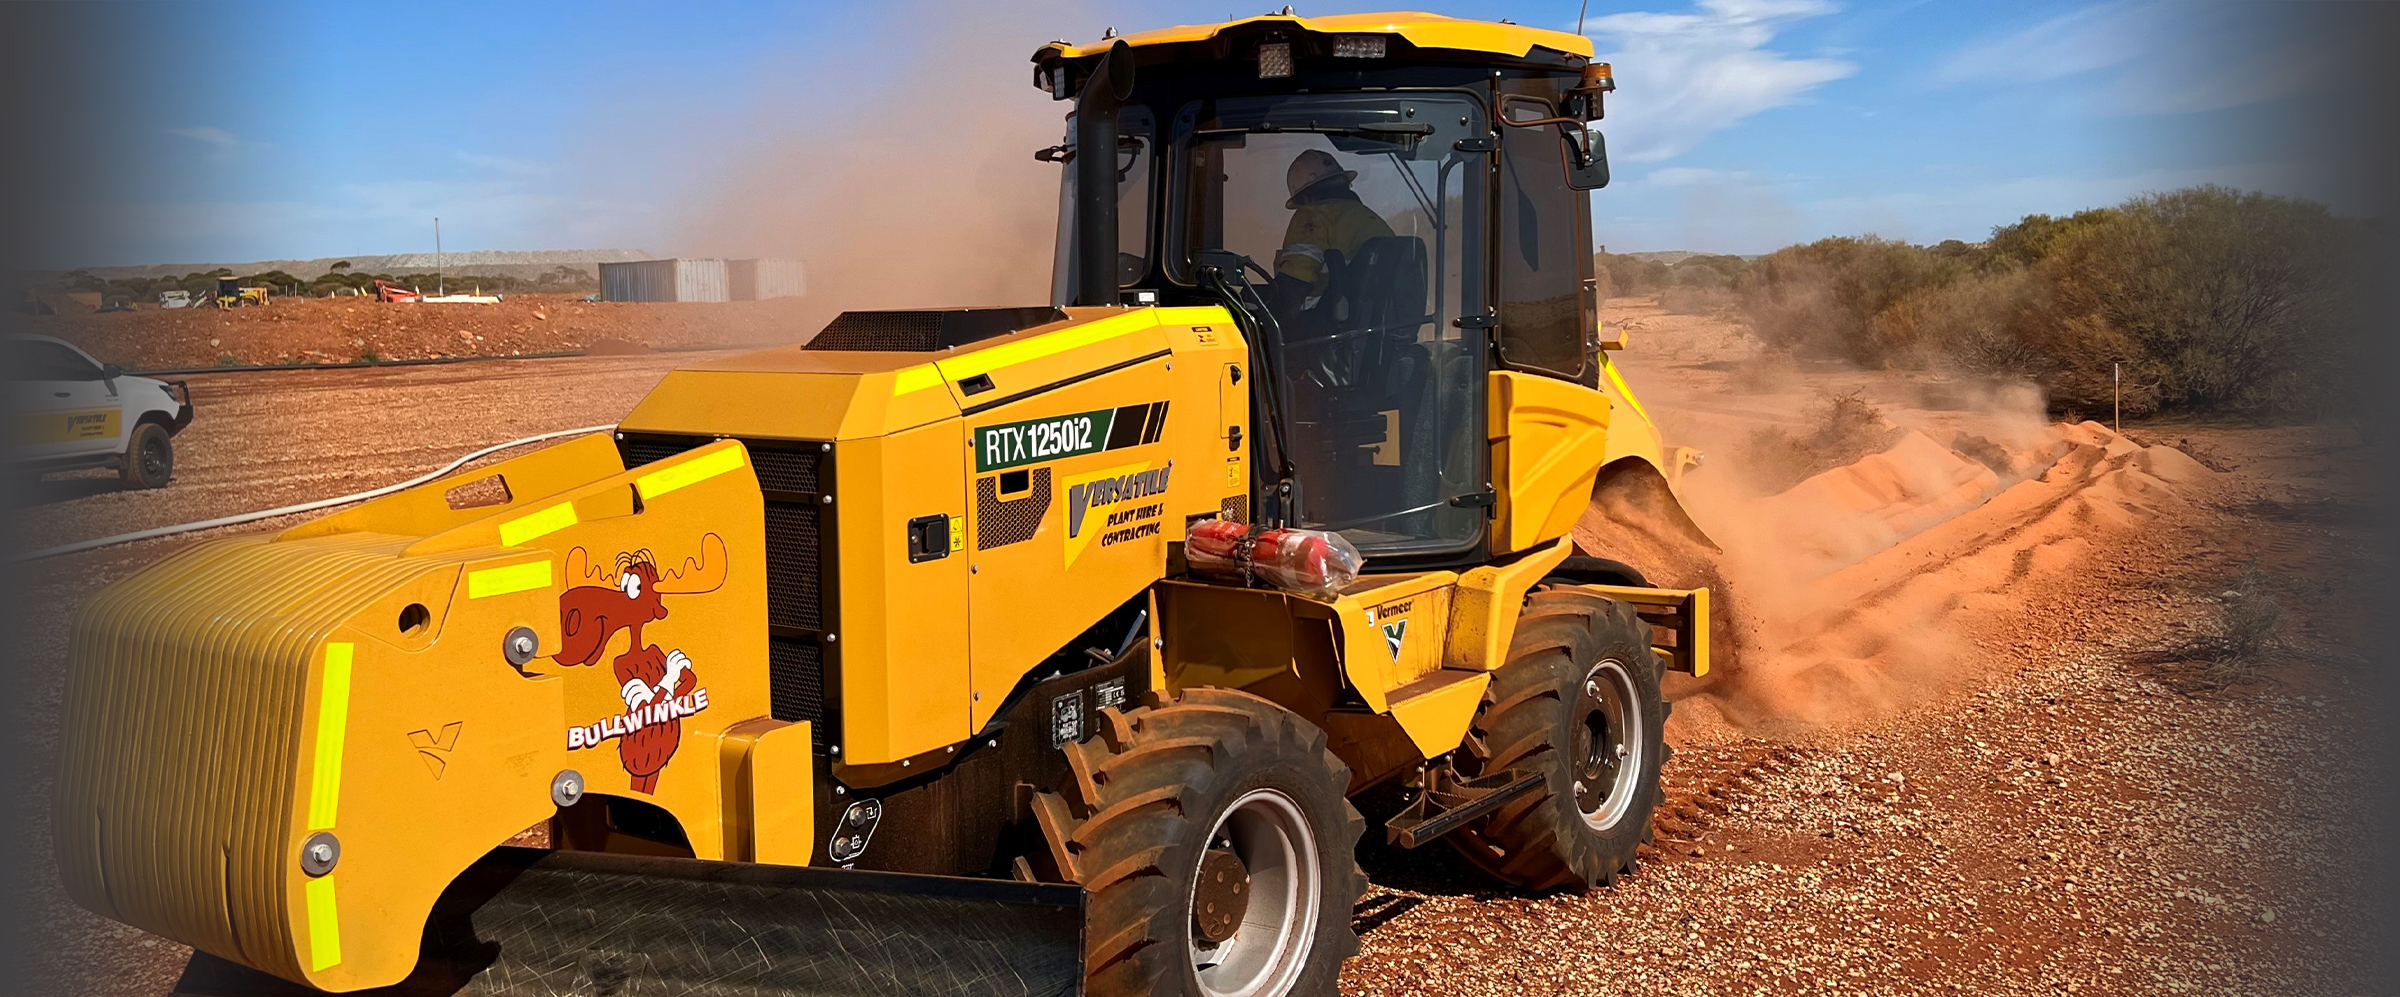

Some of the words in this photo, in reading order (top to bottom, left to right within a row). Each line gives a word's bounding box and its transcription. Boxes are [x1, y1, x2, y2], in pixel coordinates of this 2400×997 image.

[1069, 467, 1170, 539] VERSATILE
[1107, 509, 1135, 527] PLANT
[1136, 504, 1158, 521] HIRE
[1158, 503, 1164, 516] &
[1101, 522, 1160, 547] CONTRACTING
[1376, 601, 1412, 620] Vermeer
[567, 687, 709, 751] BULLWINKLE
